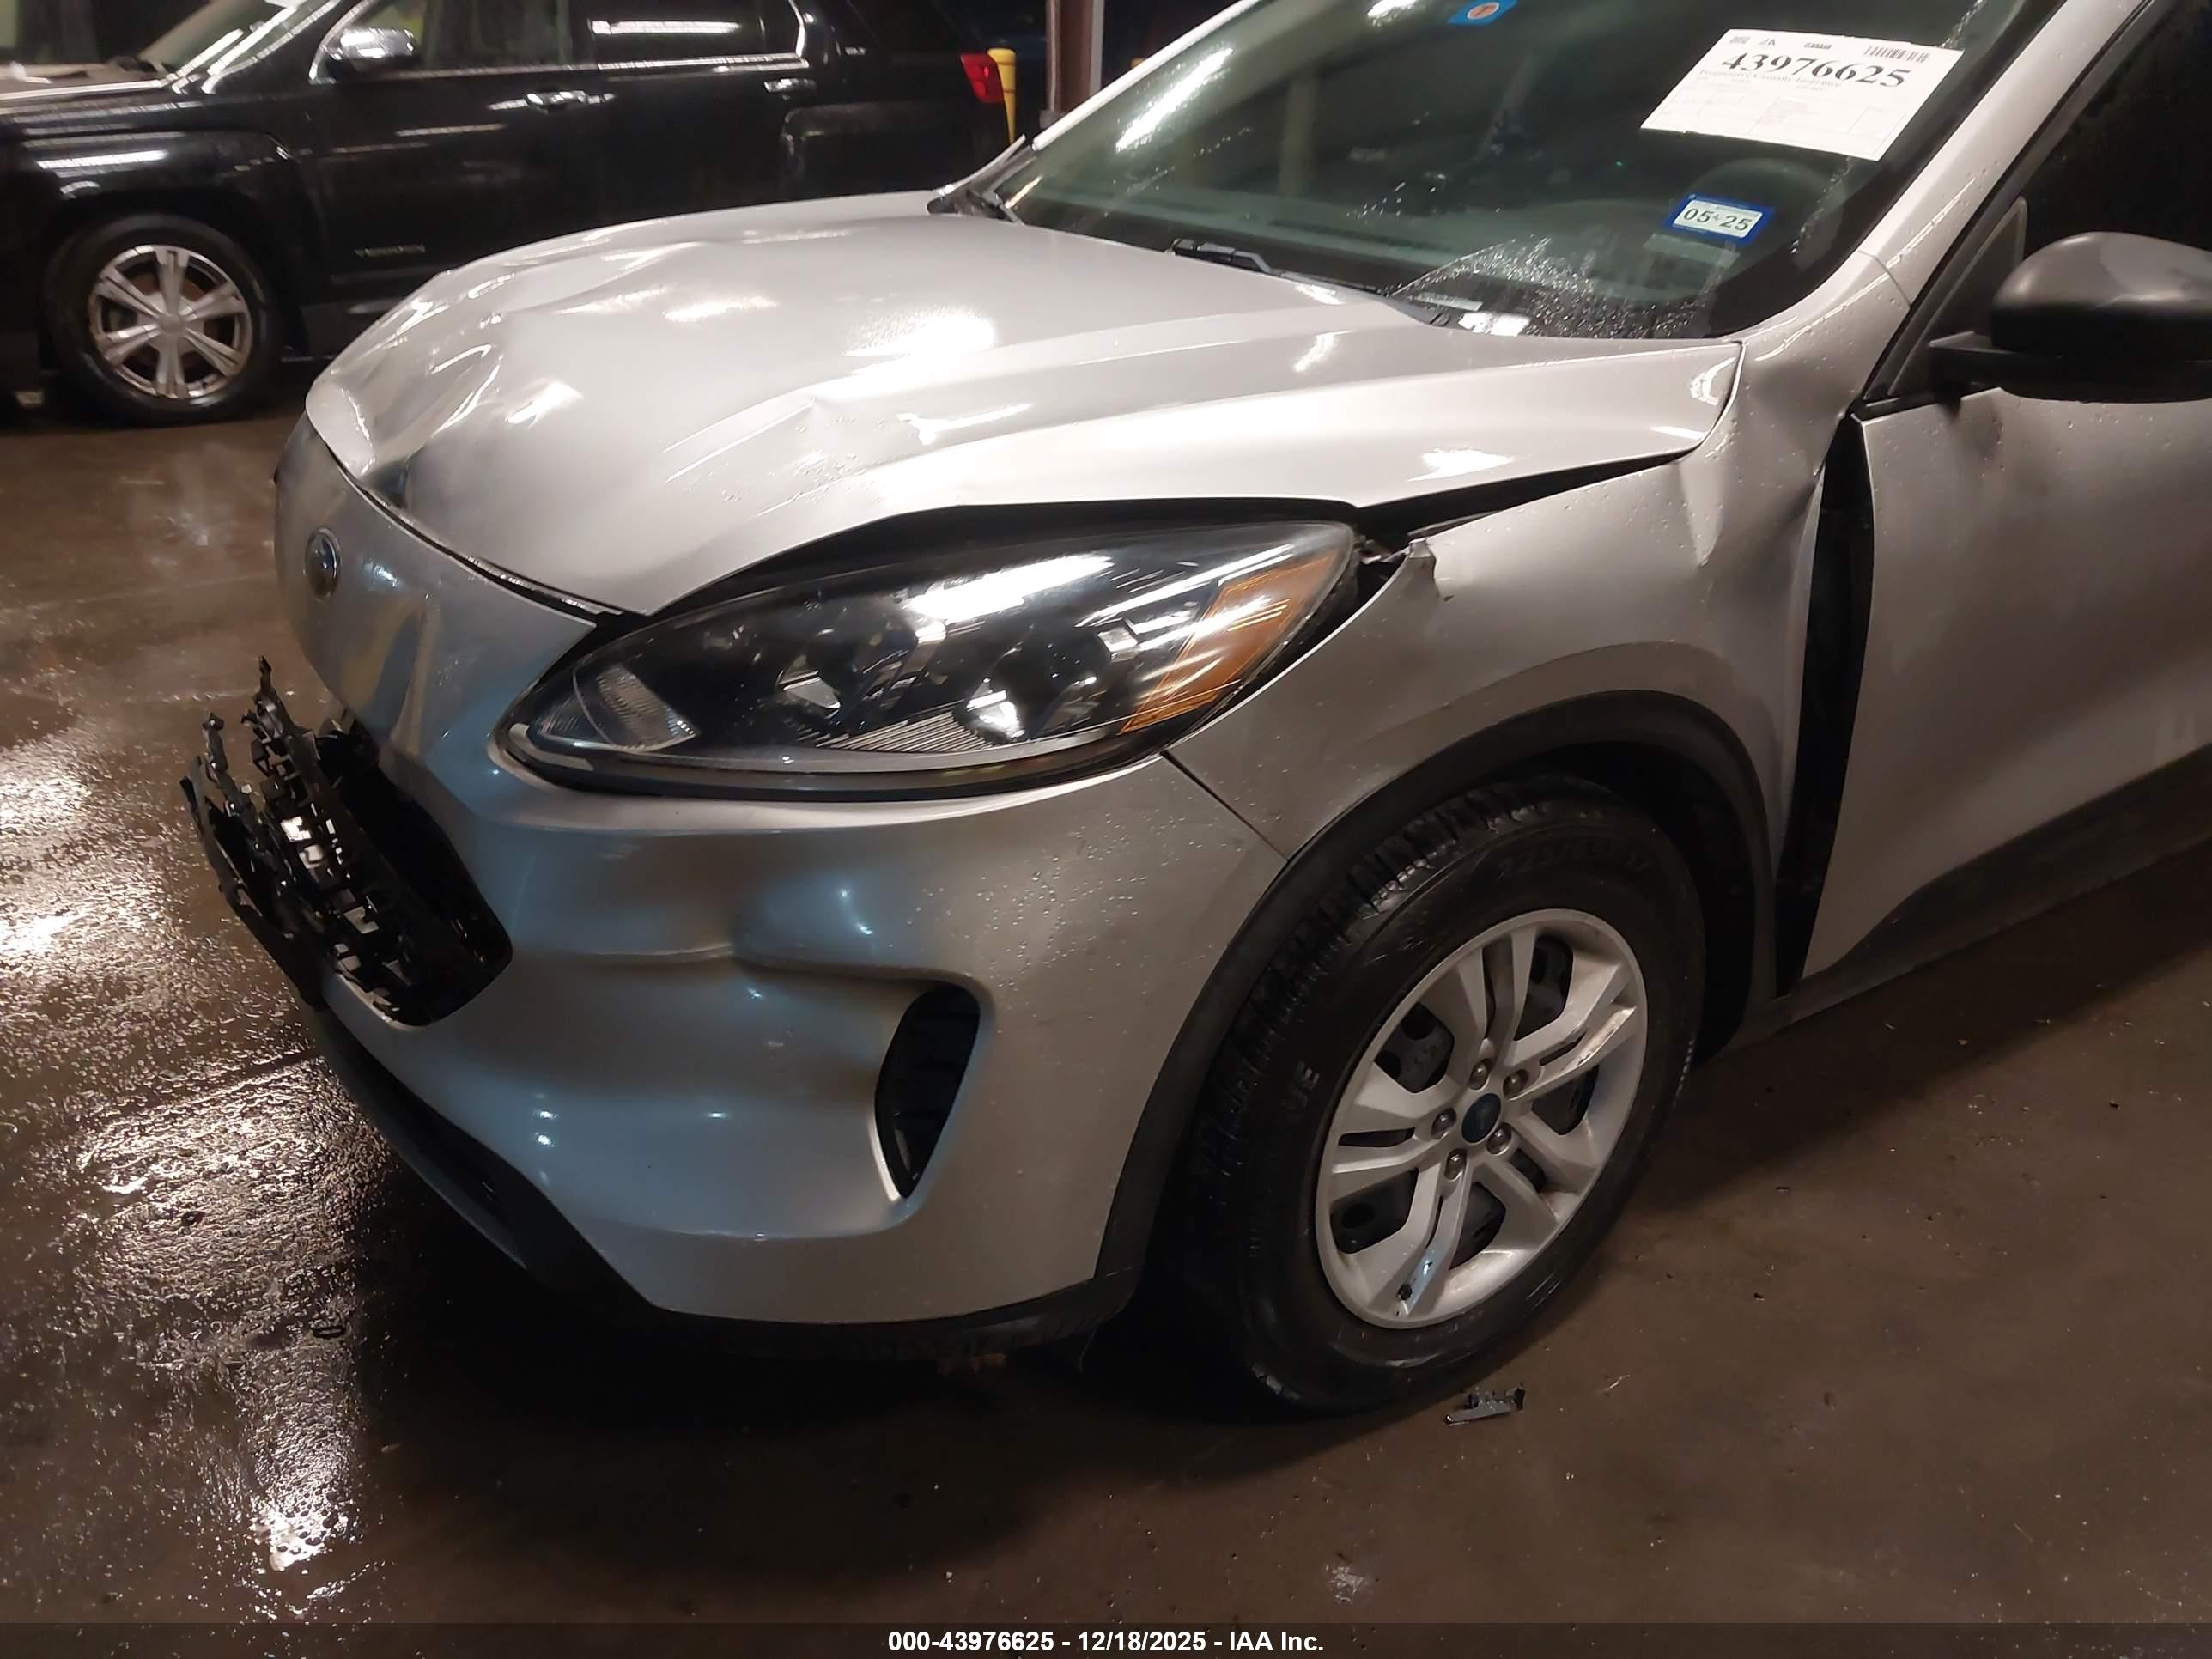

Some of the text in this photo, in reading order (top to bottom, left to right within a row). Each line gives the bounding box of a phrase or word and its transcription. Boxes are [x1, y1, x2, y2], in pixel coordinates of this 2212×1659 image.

[1722, 52, 1911, 87] 43976625
[1684, 208, 1751, 231] 05 25
